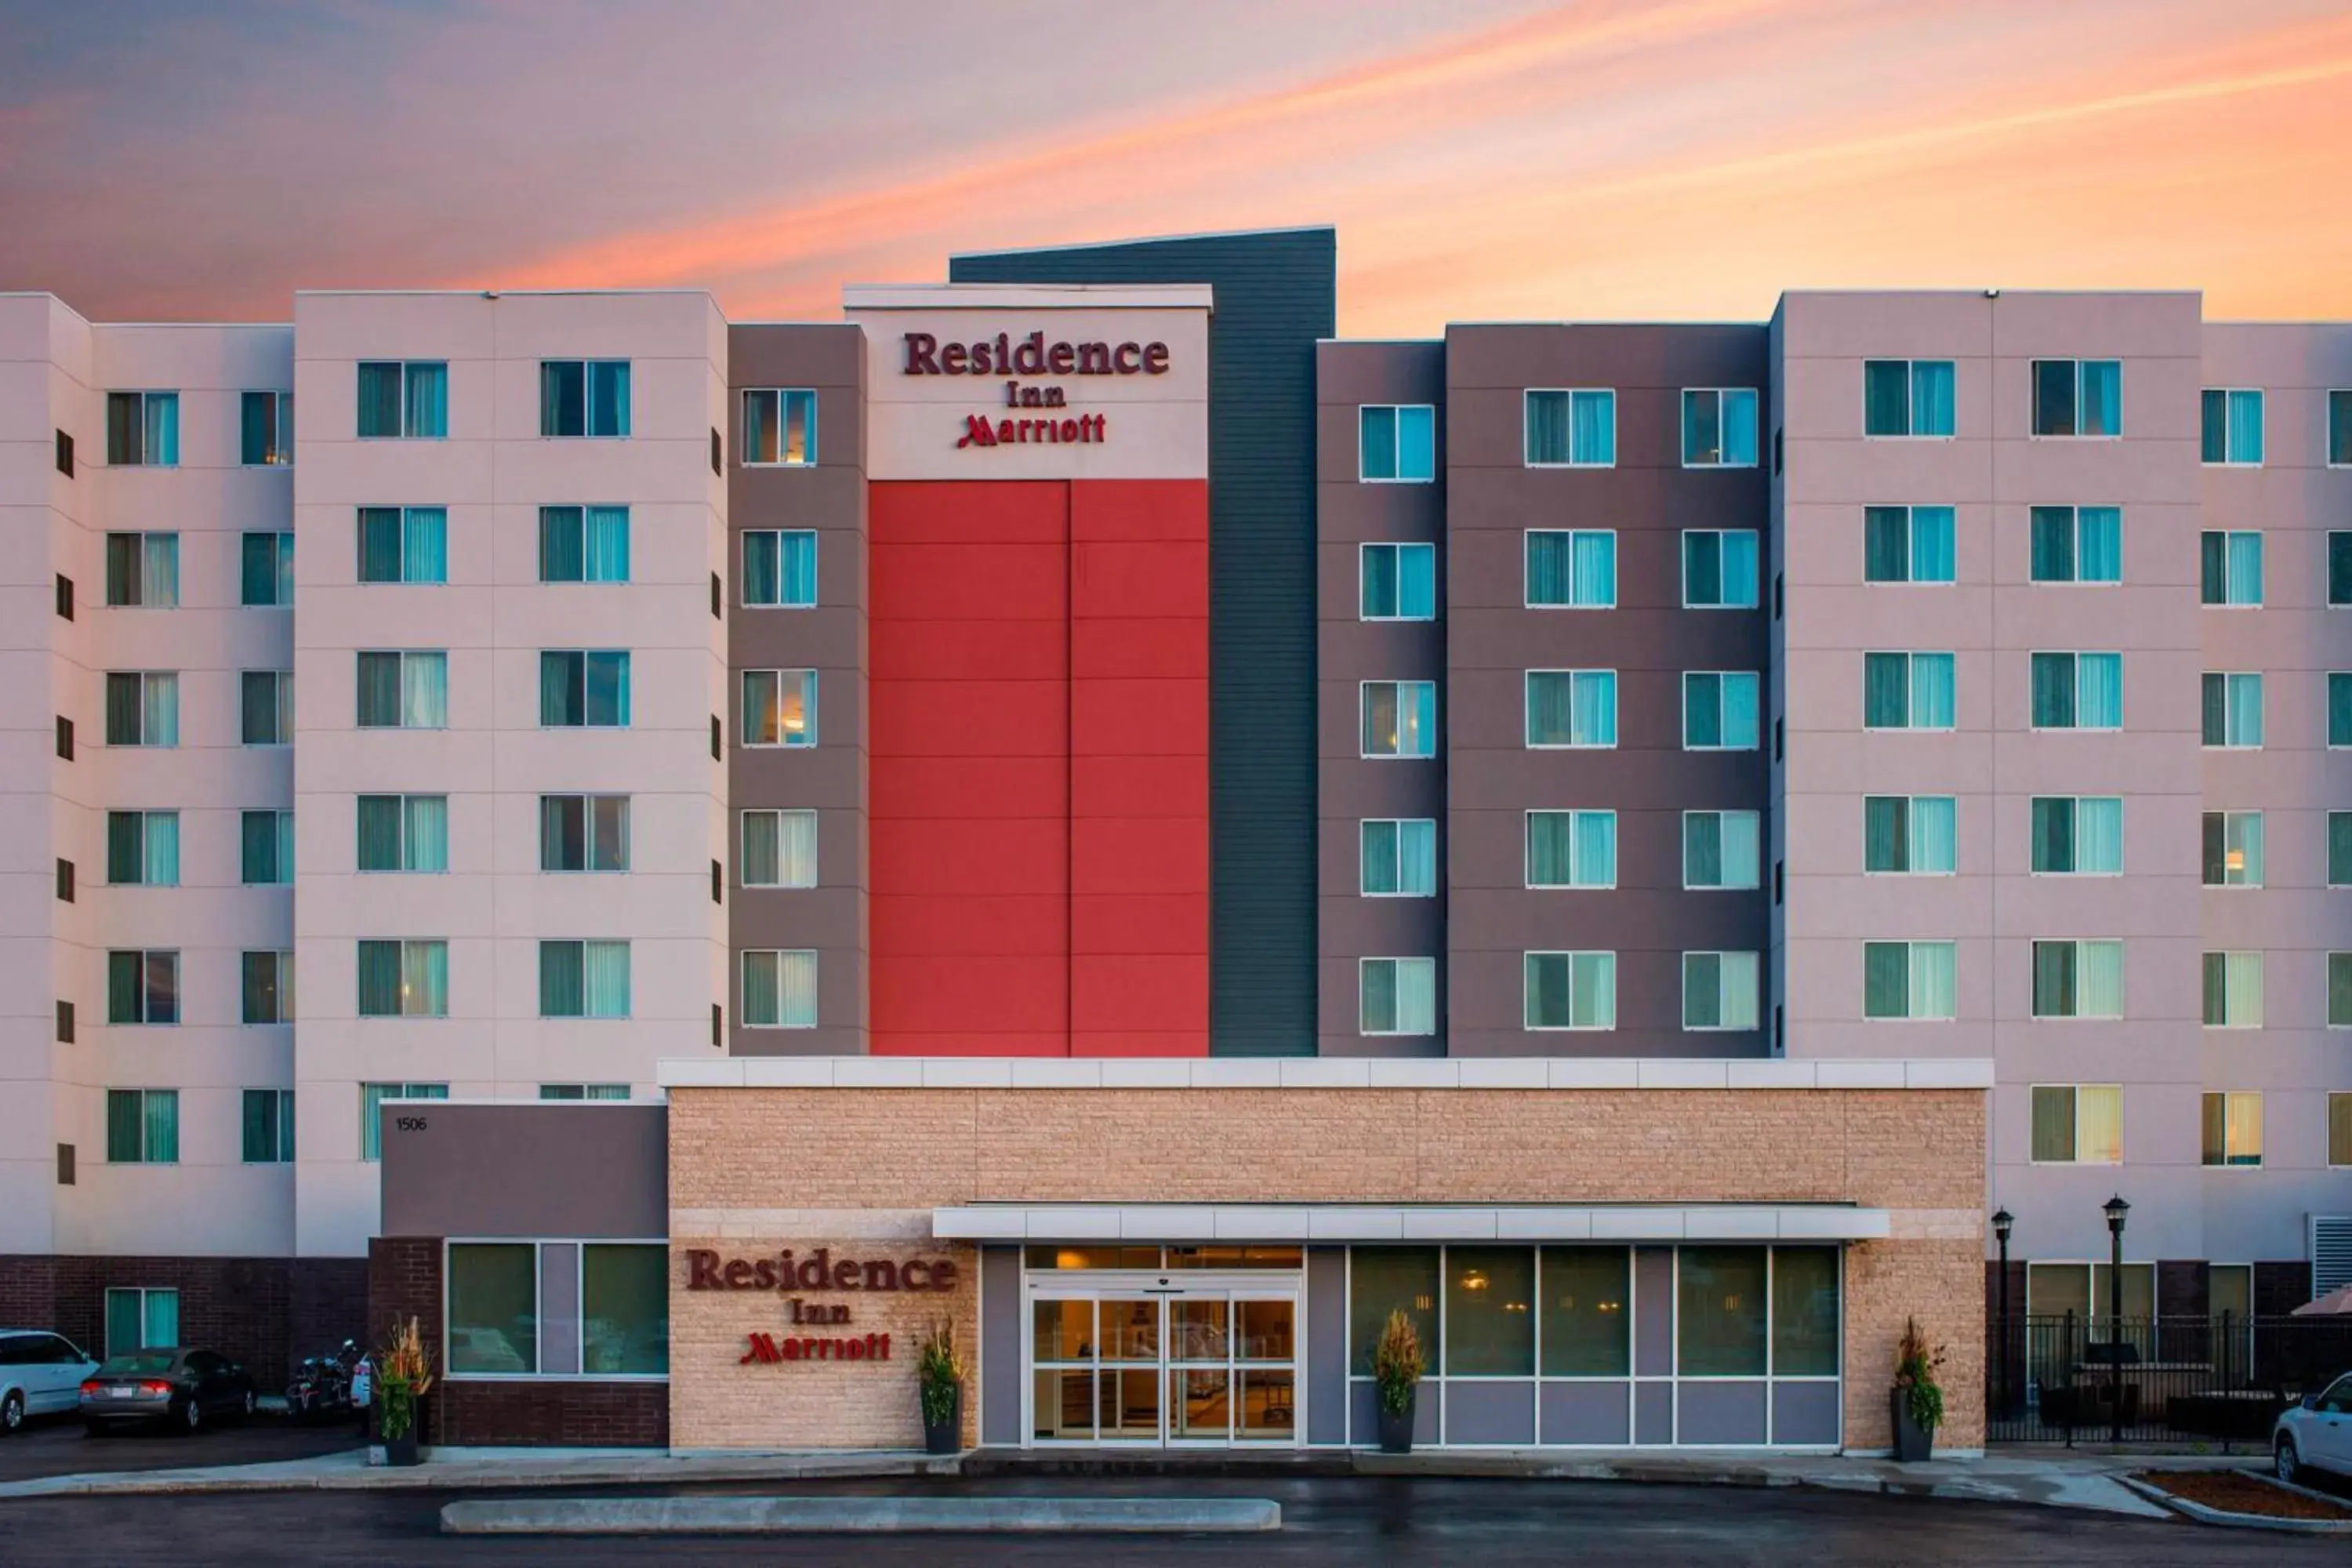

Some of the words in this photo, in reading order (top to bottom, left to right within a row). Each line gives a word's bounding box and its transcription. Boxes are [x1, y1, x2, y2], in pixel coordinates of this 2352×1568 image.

[903, 331, 1170, 376] Residence
[1006, 381, 1066, 408] Inn
[956, 412, 1106, 448] Marriott
[397, 1117, 427, 1131] 1506
[686, 1248, 957, 1292] Residence
[791, 1298, 852, 1325] Inn
[739, 1332, 891, 1364] Marriott
